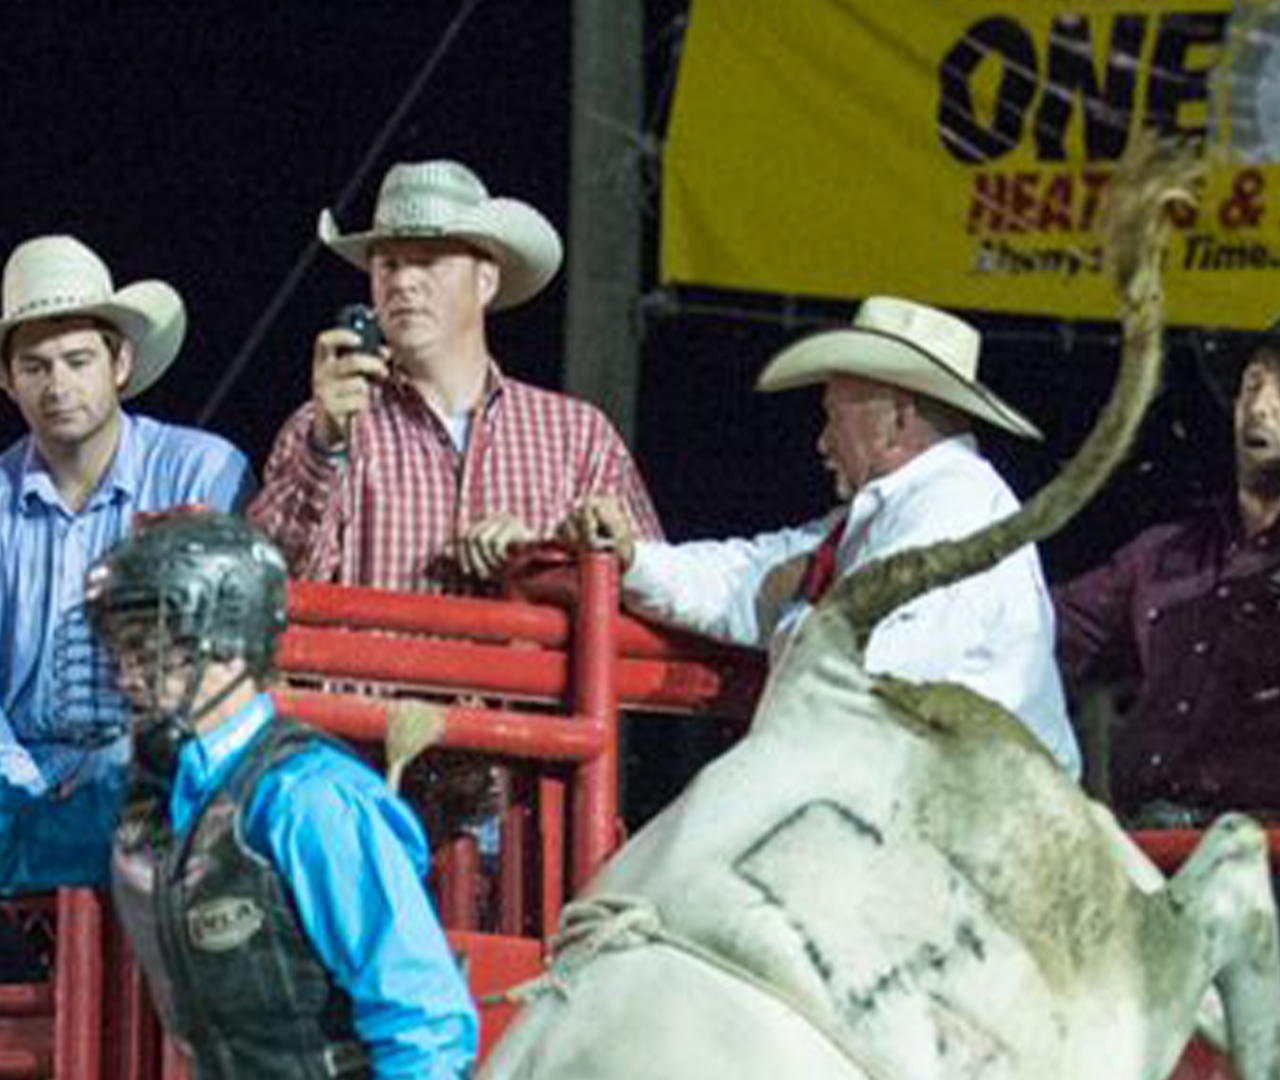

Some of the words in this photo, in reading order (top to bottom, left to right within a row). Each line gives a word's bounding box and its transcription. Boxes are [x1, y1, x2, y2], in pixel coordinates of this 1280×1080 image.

[937, 13, 1232, 164] ONE
[967, 168, 1200, 234] HEATG
[1219, 166, 1267, 228] &
